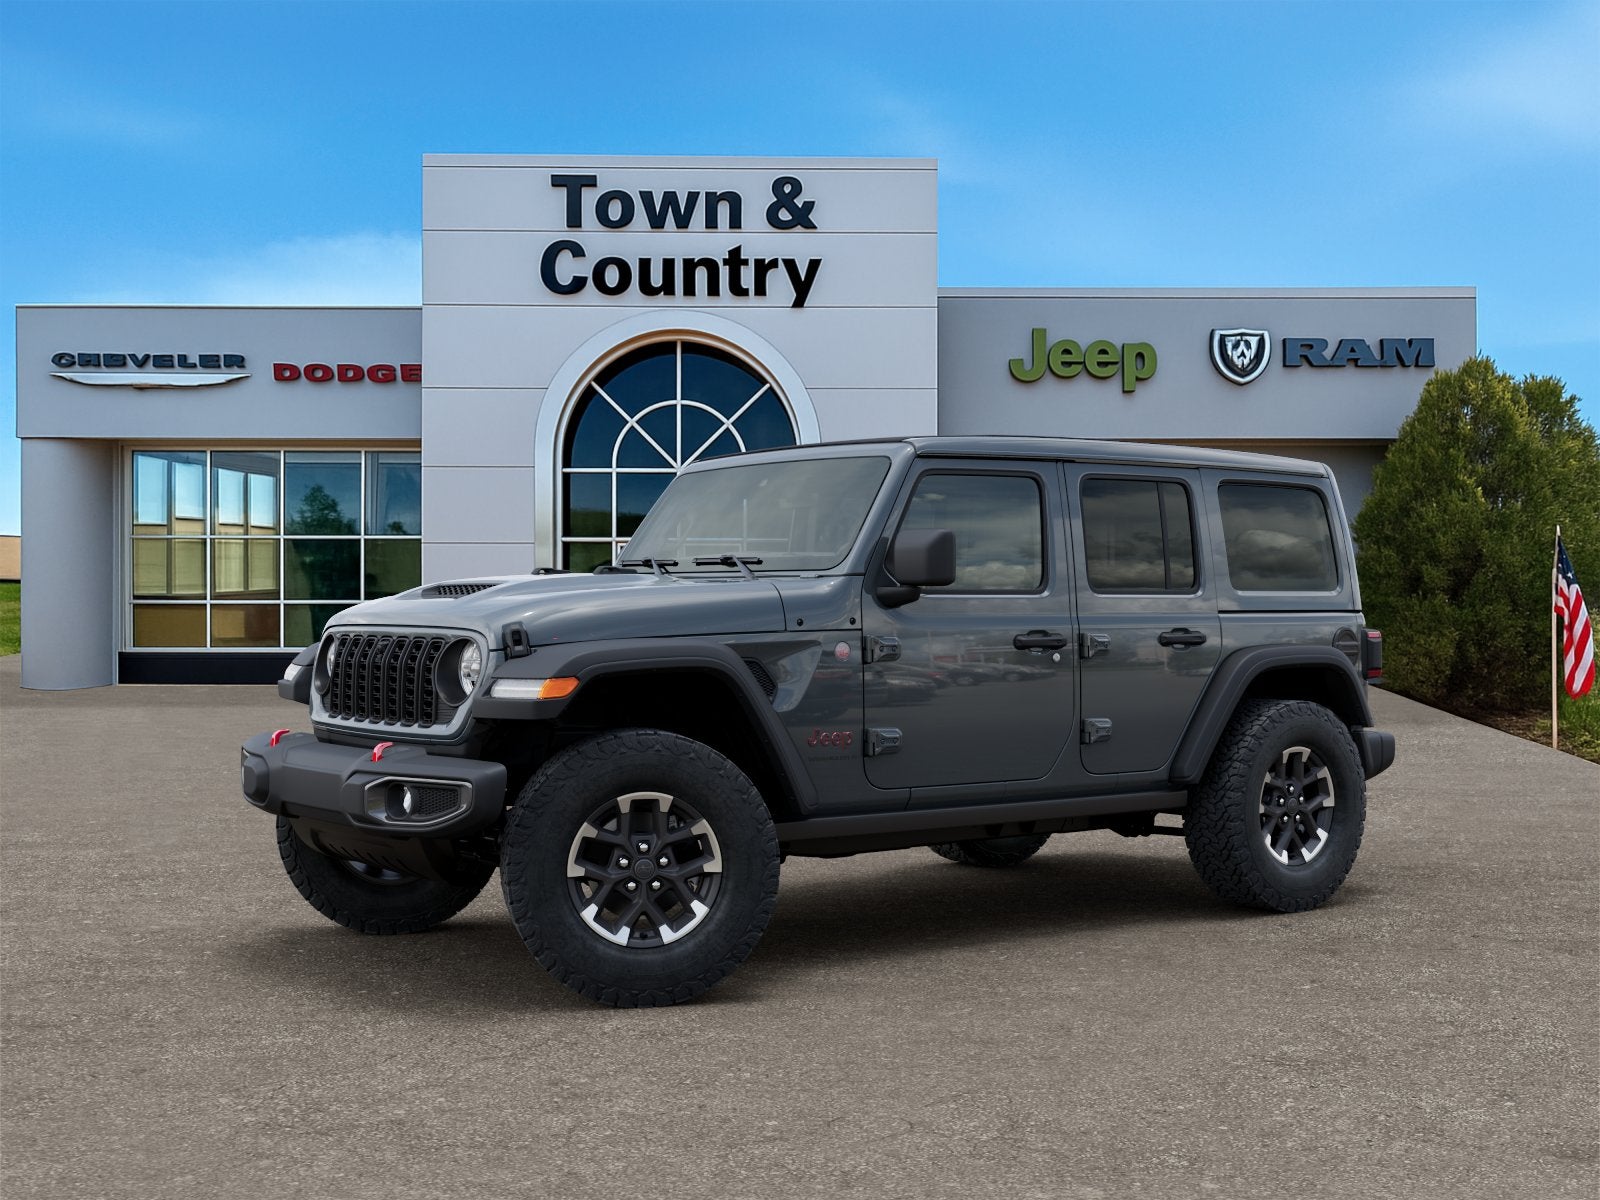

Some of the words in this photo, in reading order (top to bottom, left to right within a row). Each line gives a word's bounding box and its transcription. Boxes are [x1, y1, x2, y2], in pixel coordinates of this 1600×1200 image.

[551, 174, 742, 229] Town
[765, 176, 818, 230] &
[540, 239, 822, 308] Country
[273, 363, 422, 383] DODGE
[1008, 328, 1157, 393] Jeep
[1282, 337, 1435, 368] RAM
[807, 728, 853, 752] Jeep
